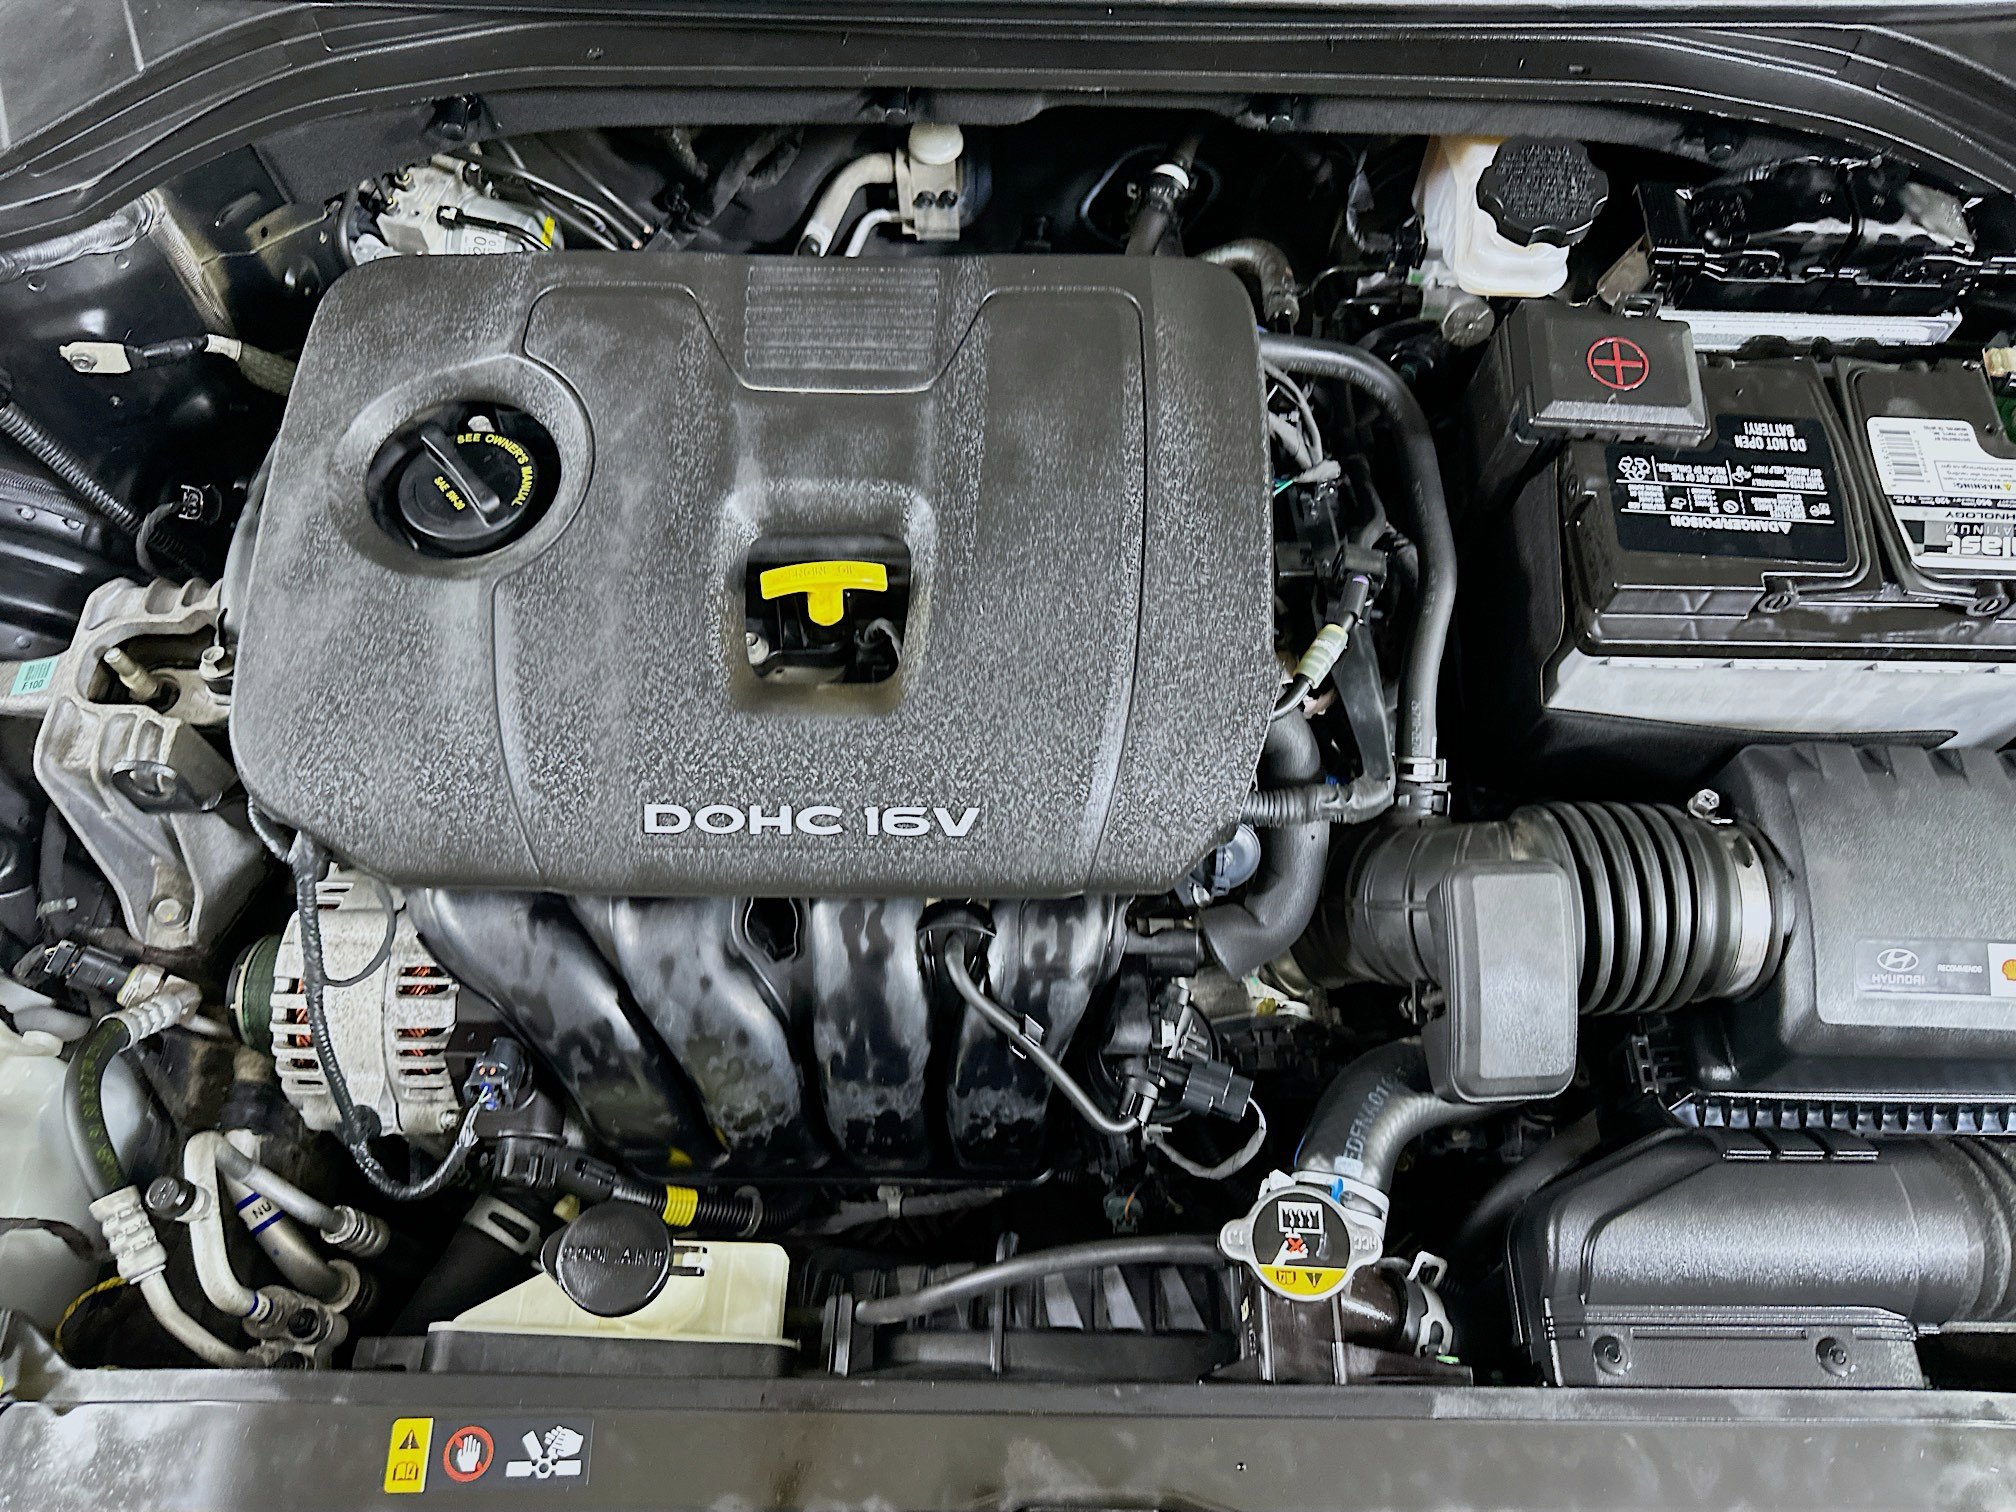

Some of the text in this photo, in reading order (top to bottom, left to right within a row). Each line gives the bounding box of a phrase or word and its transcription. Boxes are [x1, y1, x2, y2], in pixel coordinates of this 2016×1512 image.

[1744, 422, 1795, 438] BATTERY!
[1734, 435, 1807, 452] DO NOT OPEN
[457, 433, 533, 506] SEE OWNER'S MANUAL
[434, 476, 450, 492] SAE
[1670, 515, 1779, 533] DANGER/POISON
[1945, 523, 2016, 537] ATINUM
[1945, 534, 2016, 558] last
[22, 679, 44, 692] F100
[644, 803, 981, 837] DOHC 16V
[1937, 963, 1983, 974] RECOMMENDS
[1871, 973, 1925, 985] HYUNDAI
[252, 1201, 272, 1219] NU
